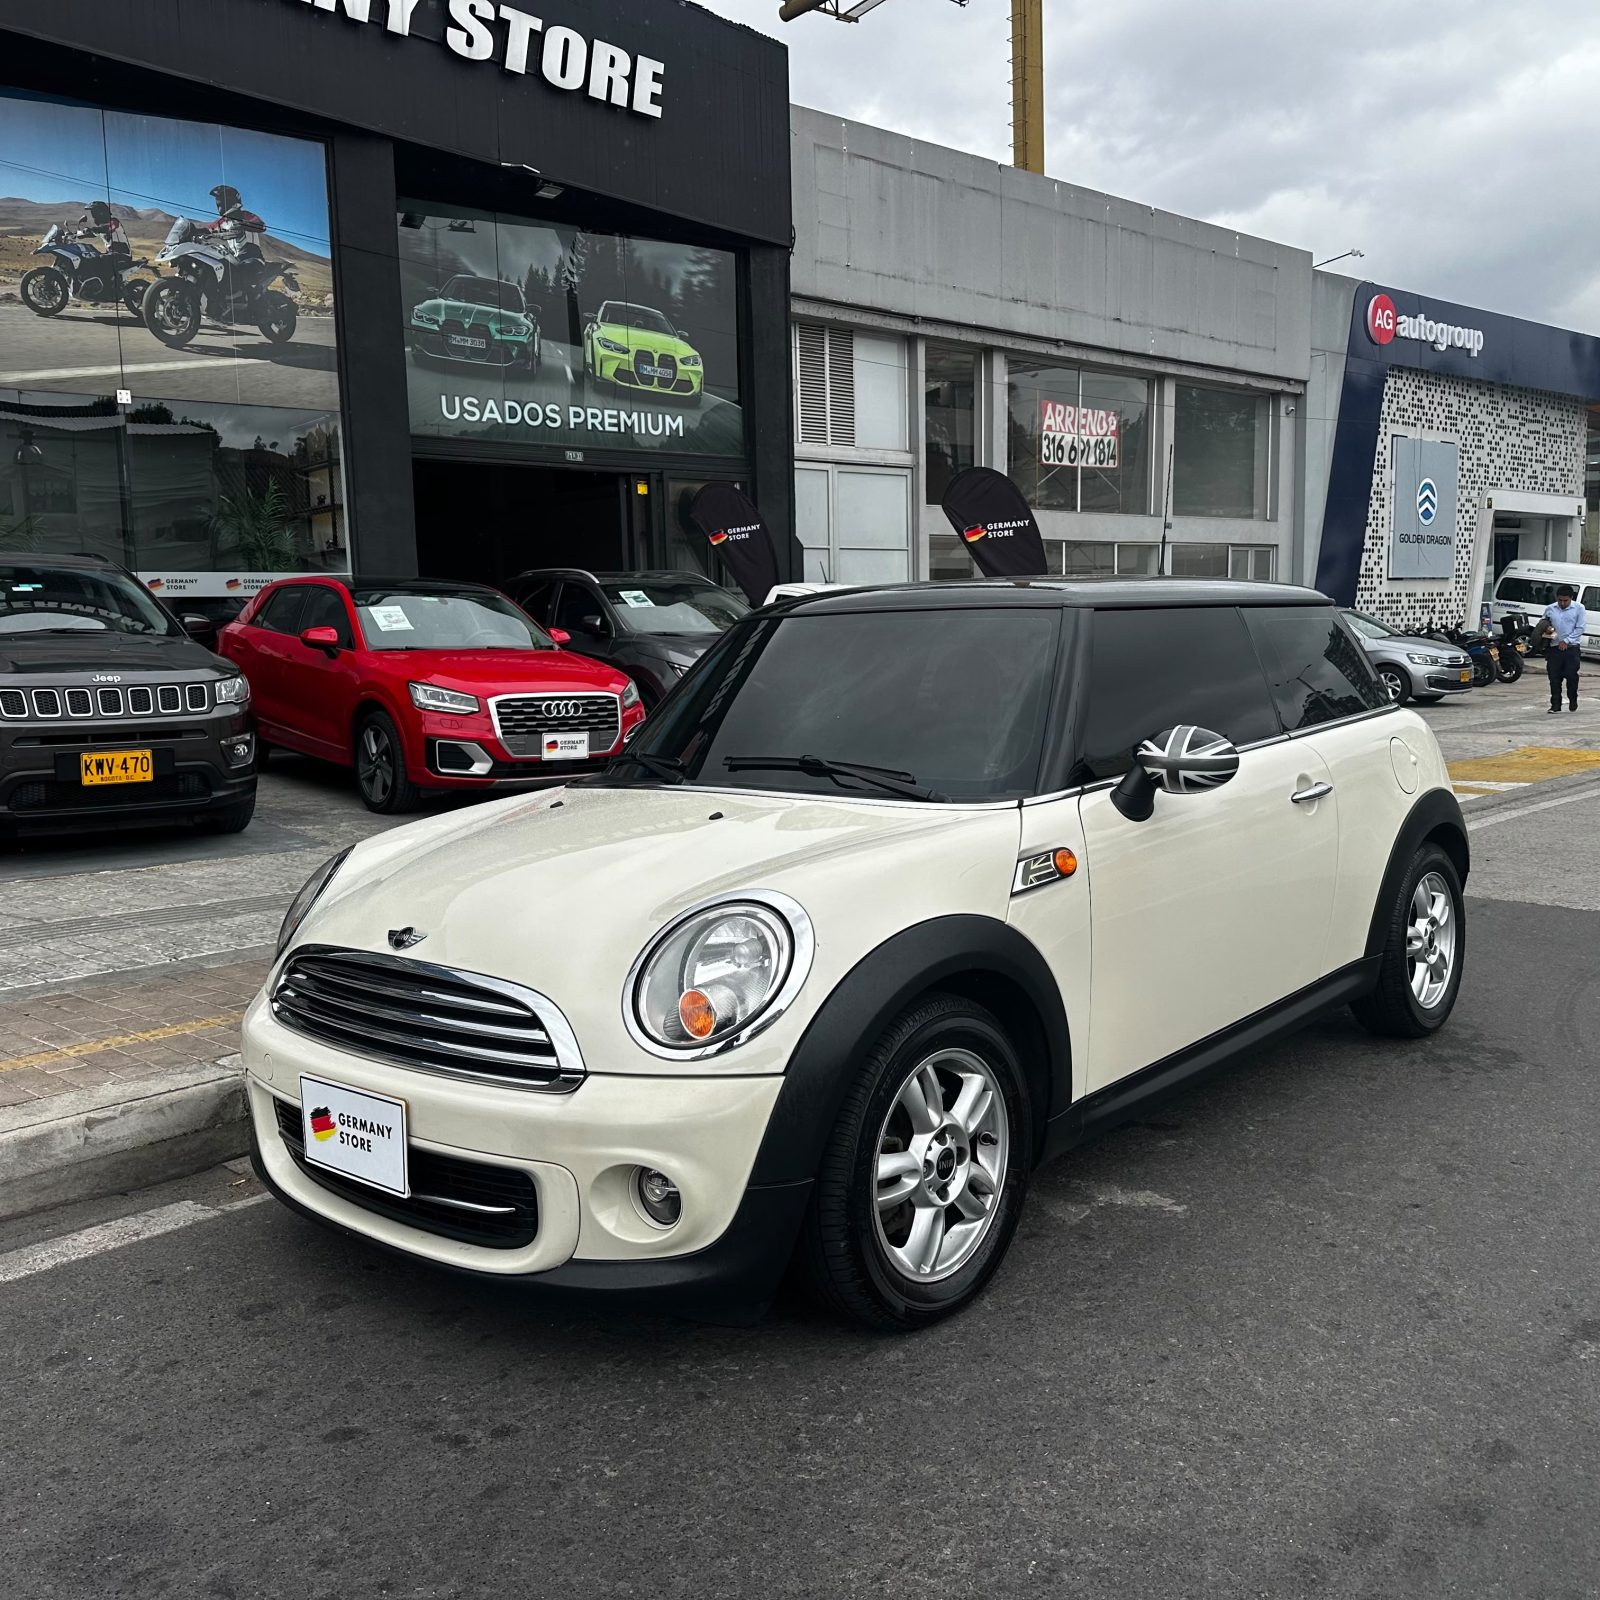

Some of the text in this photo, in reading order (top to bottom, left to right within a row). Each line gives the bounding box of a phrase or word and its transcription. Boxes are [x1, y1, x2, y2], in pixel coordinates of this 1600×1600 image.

[446, 0, 665, 119] STORE
[1374, 308, 1393, 330] AG
[1396, 313, 1484, 357] autogroup
[440, 394, 684, 438] USADOS PREMIUM
[727, 523, 761, 535] GERMANY
[986, 519, 1030, 530] GERMANY
[987, 529, 1014, 539] STORE
[728, 532, 750, 541] STORE
[1399, 533, 1452, 546] GOLDEN DRAGON
[92, 674, 121, 683] Jeep
[84, 755, 150, 777] KWV 470
[338, 1112, 393, 1140] GERMANY
[339, 1131, 372, 1153] STORE
